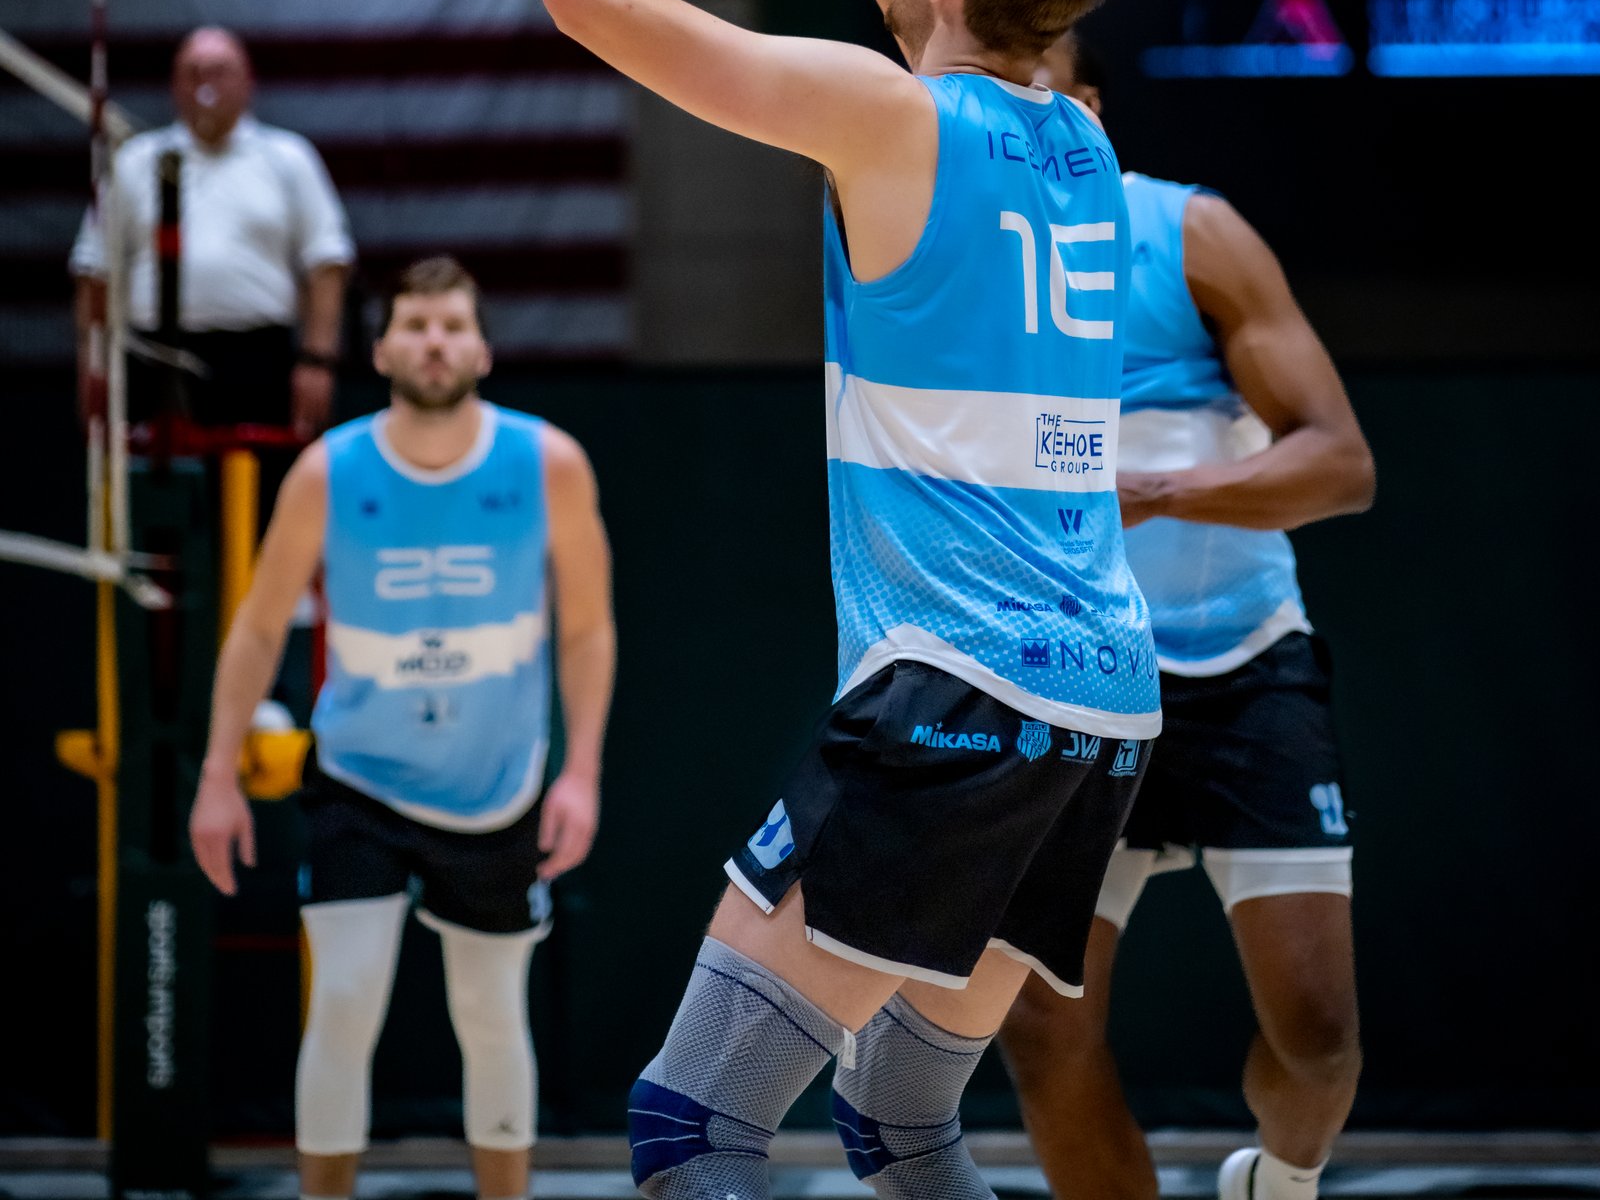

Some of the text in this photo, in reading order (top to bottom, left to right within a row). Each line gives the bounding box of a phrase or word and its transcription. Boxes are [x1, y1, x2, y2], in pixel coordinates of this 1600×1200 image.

[1041, 413, 1061, 427] THE
[1041, 430, 1103, 457] KEHOE
[1050, 460, 1090, 474] GROUP
[374, 545, 495, 600] 25
[1061, 732, 1102, 760] JVA
